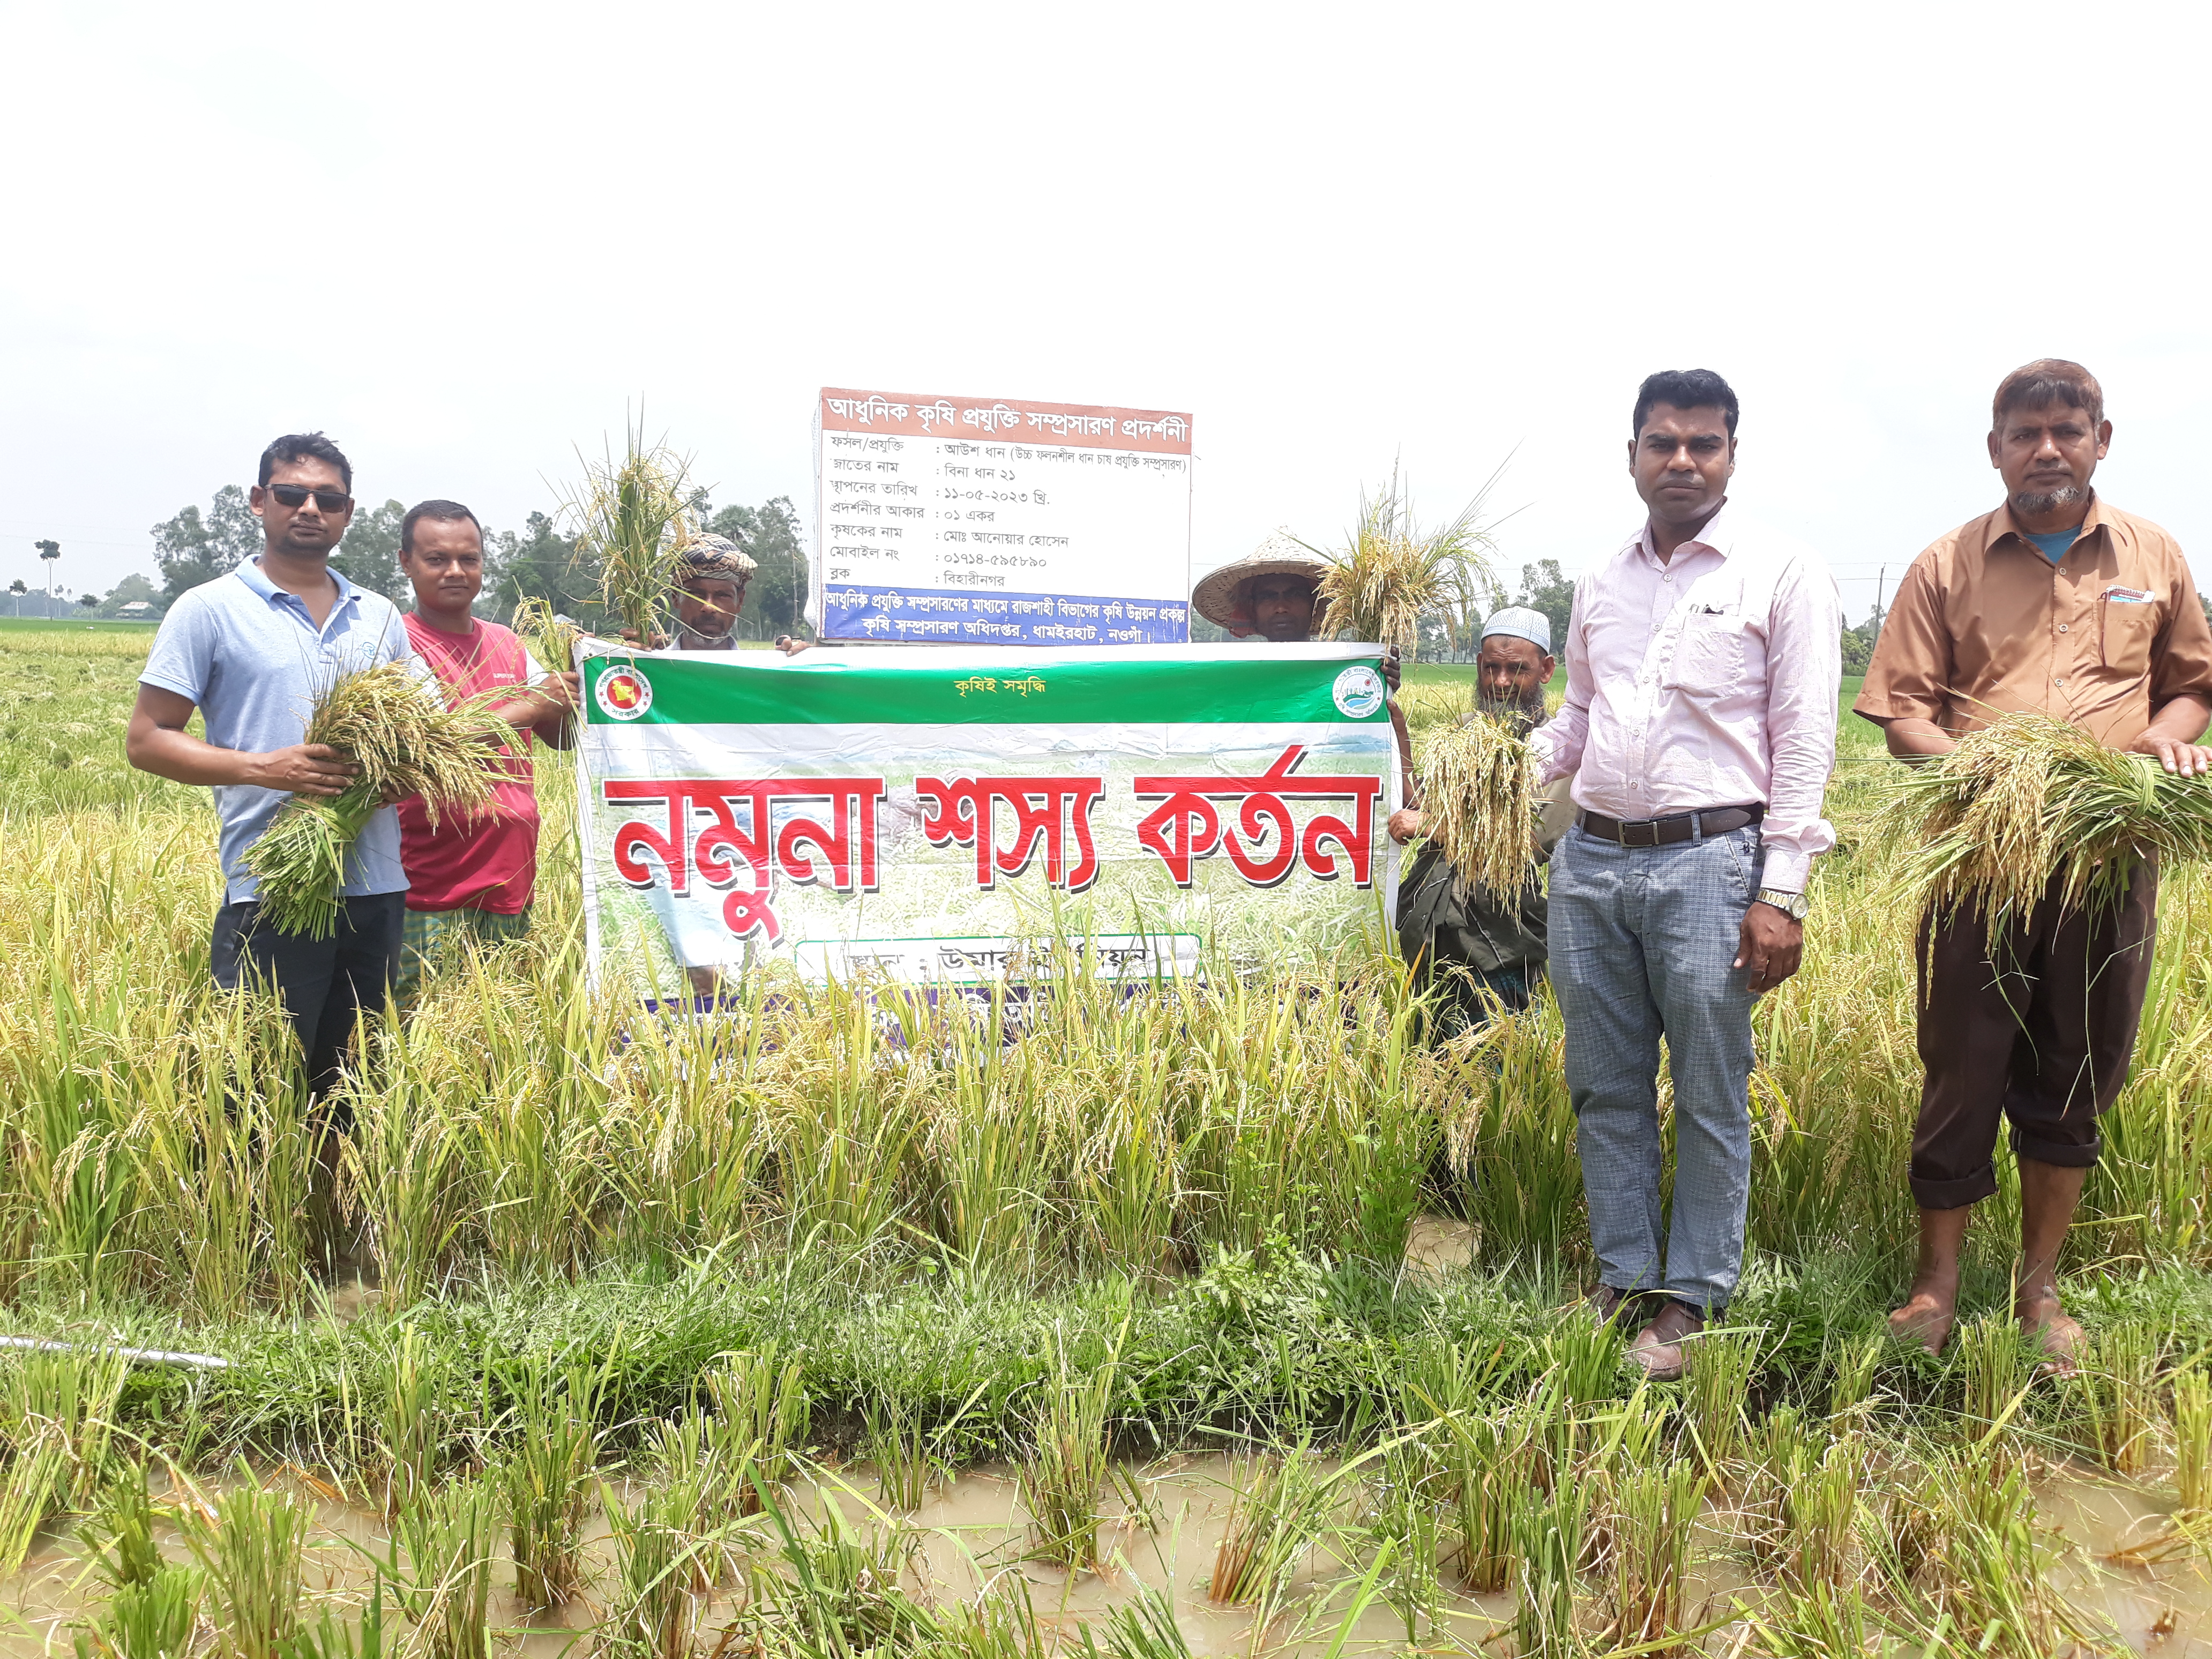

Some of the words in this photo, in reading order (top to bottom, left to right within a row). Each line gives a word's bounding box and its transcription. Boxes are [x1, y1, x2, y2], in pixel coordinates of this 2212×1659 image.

[826, 395, 910, 427] আধুনিক
[914, 400, 957, 434] কৃষি
[962, 403, 1022, 434] প্রযুক্তি
[1025, 412, 1117, 437] সম্প্রসারণ
[1121, 416, 1189, 443] প্রদর্শনী
[831, 437, 904, 454] ফসল/প্রযুক্তি
[944, 442, 980, 457] আউশ
[985, 447, 1006, 459] ধান
[1011, 445, 1033, 462] (উচ্চ
[1036, 448, 1075, 463] ফলনশীল
[1079, 453, 1094, 465] ধান
[1097, 454, 1111, 465] চাষ
[1115, 453, 1140, 469] প্রযুক্তি
[1142, 458, 1186, 474] সম্প্রসারণ)
[831, 459, 872, 472] জাতের
[876, 461, 900, 473] নাম
[944, 462, 969, 477] বিনা
[975, 468, 996, 479] ধান
[1000, 470, 1015, 482] ২১
[829, 480, 877, 494] স্থাপনের
[881, 481, 918, 496] তারিখ
[945, 488, 1028, 503] ১১-০৫-২০২৩
[1033, 489, 1050, 505] খ্রি.
[830, 500, 881, 515] প্রদর্শনীর
[885, 506, 925, 518] আকার
[945, 510, 960, 520] ০১
[966, 511, 995, 522] একর
[830, 524, 876, 540] কৃষকের
[880, 527, 903, 538] নাম
[944, 531, 966, 542] মোঃ
[971, 532, 1025, 545] আনোয়ার
[1029, 535, 1069, 548] হোসেন
[831, 544, 880, 559] মোবাইল
[884, 549, 900, 561] নং
[944, 553, 1047, 566] ০১৭১৪-৫৯৫৮৯০
[829, 568, 851, 580] ব্লক
[943, 570, 1005, 587] বিহারীনগর
[826, 588, 869, 611] আধুনিক
[871, 591, 904, 612] প্রযুক্তি
[906, 595, 969, 612] সম্প্রসারণের
[972, 598, 1008, 614] মাধ্যমে
[1011, 597, 1055, 616] রাজশাহী
[1057, 598, 1100, 618] বিভাগের
[1102, 601, 1123, 625] কৃষি
[1126, 602, 1157, 623] উন্নয়ন
[1159, 607, 1186, 623] প্রকল্প
[861, 615, 891, 637] কৃষি
[894, 619, 960, 636] সম্প্রসারণ
[953, 676, 997, 698] কৃষিই
[1002, 676, 1047, 698] সমৃদ্ধি
[611, 708, 639, 717] সরকার
[602, 776, 887, 947] নমুনা
[913, 775, 1105, 892] শস্য
[1132, 744, 1384, 890] কর্তন
